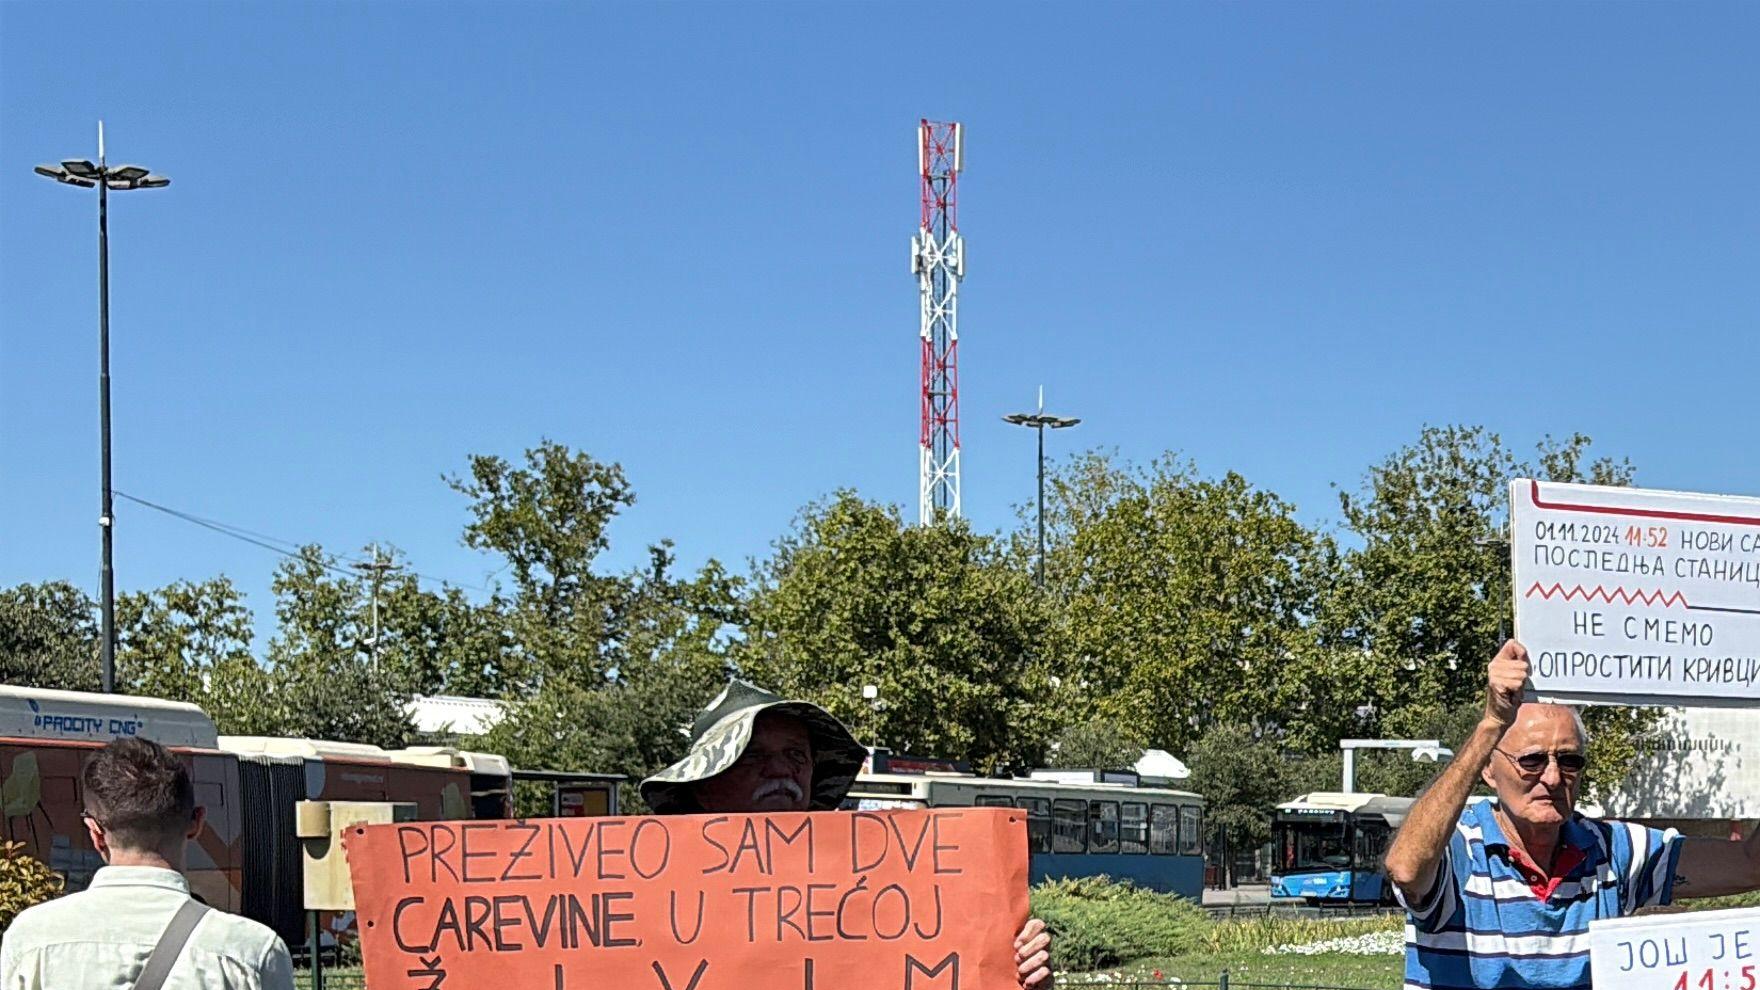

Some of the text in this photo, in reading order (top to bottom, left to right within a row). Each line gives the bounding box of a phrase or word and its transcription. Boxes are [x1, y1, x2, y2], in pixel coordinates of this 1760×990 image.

[1681, 530, 1733, 553] НОВИ
[1534, 544, 1665, 577] ПОСЛЕДЊА
[1573, 611, 1714, 647] НЕ СМЕМО
[1538, 651, 1672, 681] ОПРОСТИТИ
[109, 719, 138, 735] CNG
[398, 811, 966, 884] PREŽIVEO SAM DVE
[669, 891, 705, 944] U
[732, 875, 942, 943] TREĆOJ
[1617, 937, 1688, 972] ЈОШ
[1710, 929, 1752, 960] ЈЕ
